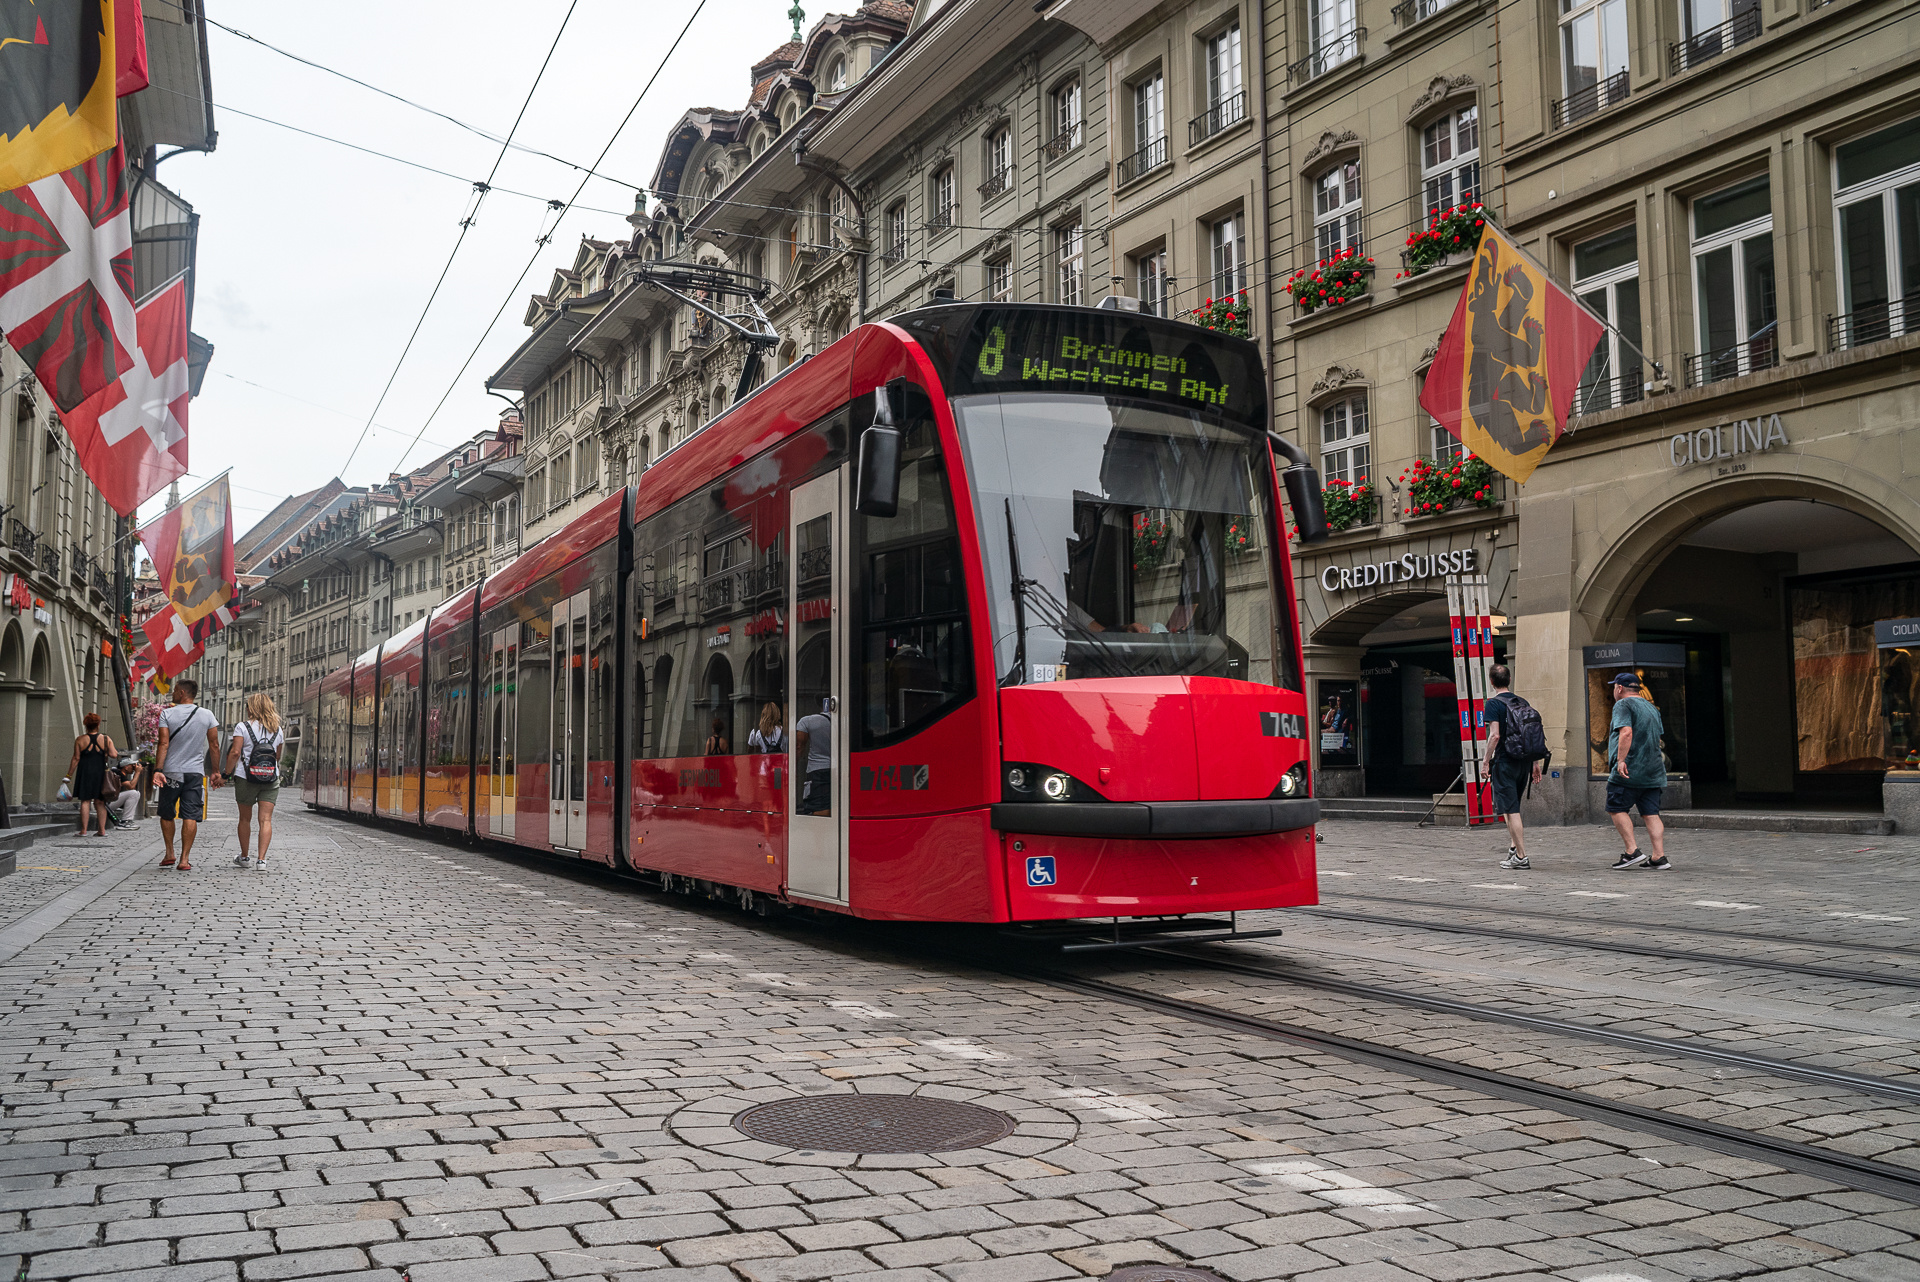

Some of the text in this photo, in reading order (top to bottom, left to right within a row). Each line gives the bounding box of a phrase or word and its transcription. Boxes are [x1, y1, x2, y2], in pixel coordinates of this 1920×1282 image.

[1061, 336, 1188, 374] Brünnen
[1180, 378, 1230, 405] Bhf
[1670, 413, 1790, 468] CIOLINA
[1321, 548, 1475, 592] CREDIT SUISSE
[1892, 623, 1920, 636] CIOLIN
[1594, 648, 1621, 659] CIOLINA
[1035, 668, 1064, 679] 804
[1269, 711, 1300, 739] 764
[869, 765, 903, 791] 764
